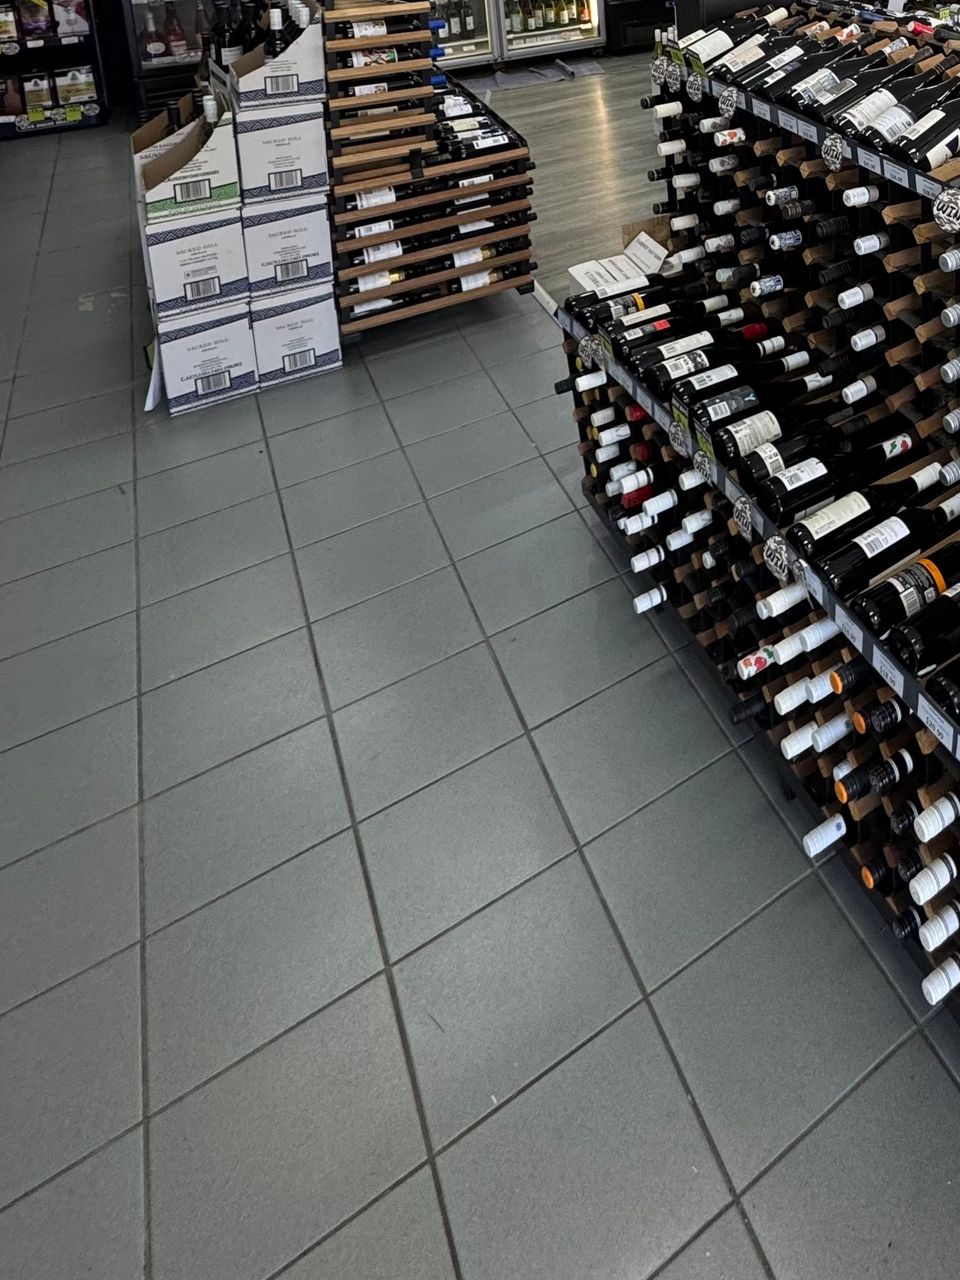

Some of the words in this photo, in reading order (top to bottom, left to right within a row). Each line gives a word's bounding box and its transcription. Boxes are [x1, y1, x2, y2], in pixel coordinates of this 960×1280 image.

[720, 96, 736, 109] WIN
[823, 144, 842, 160] WIN
[766, 548, 788, 578] WIN
